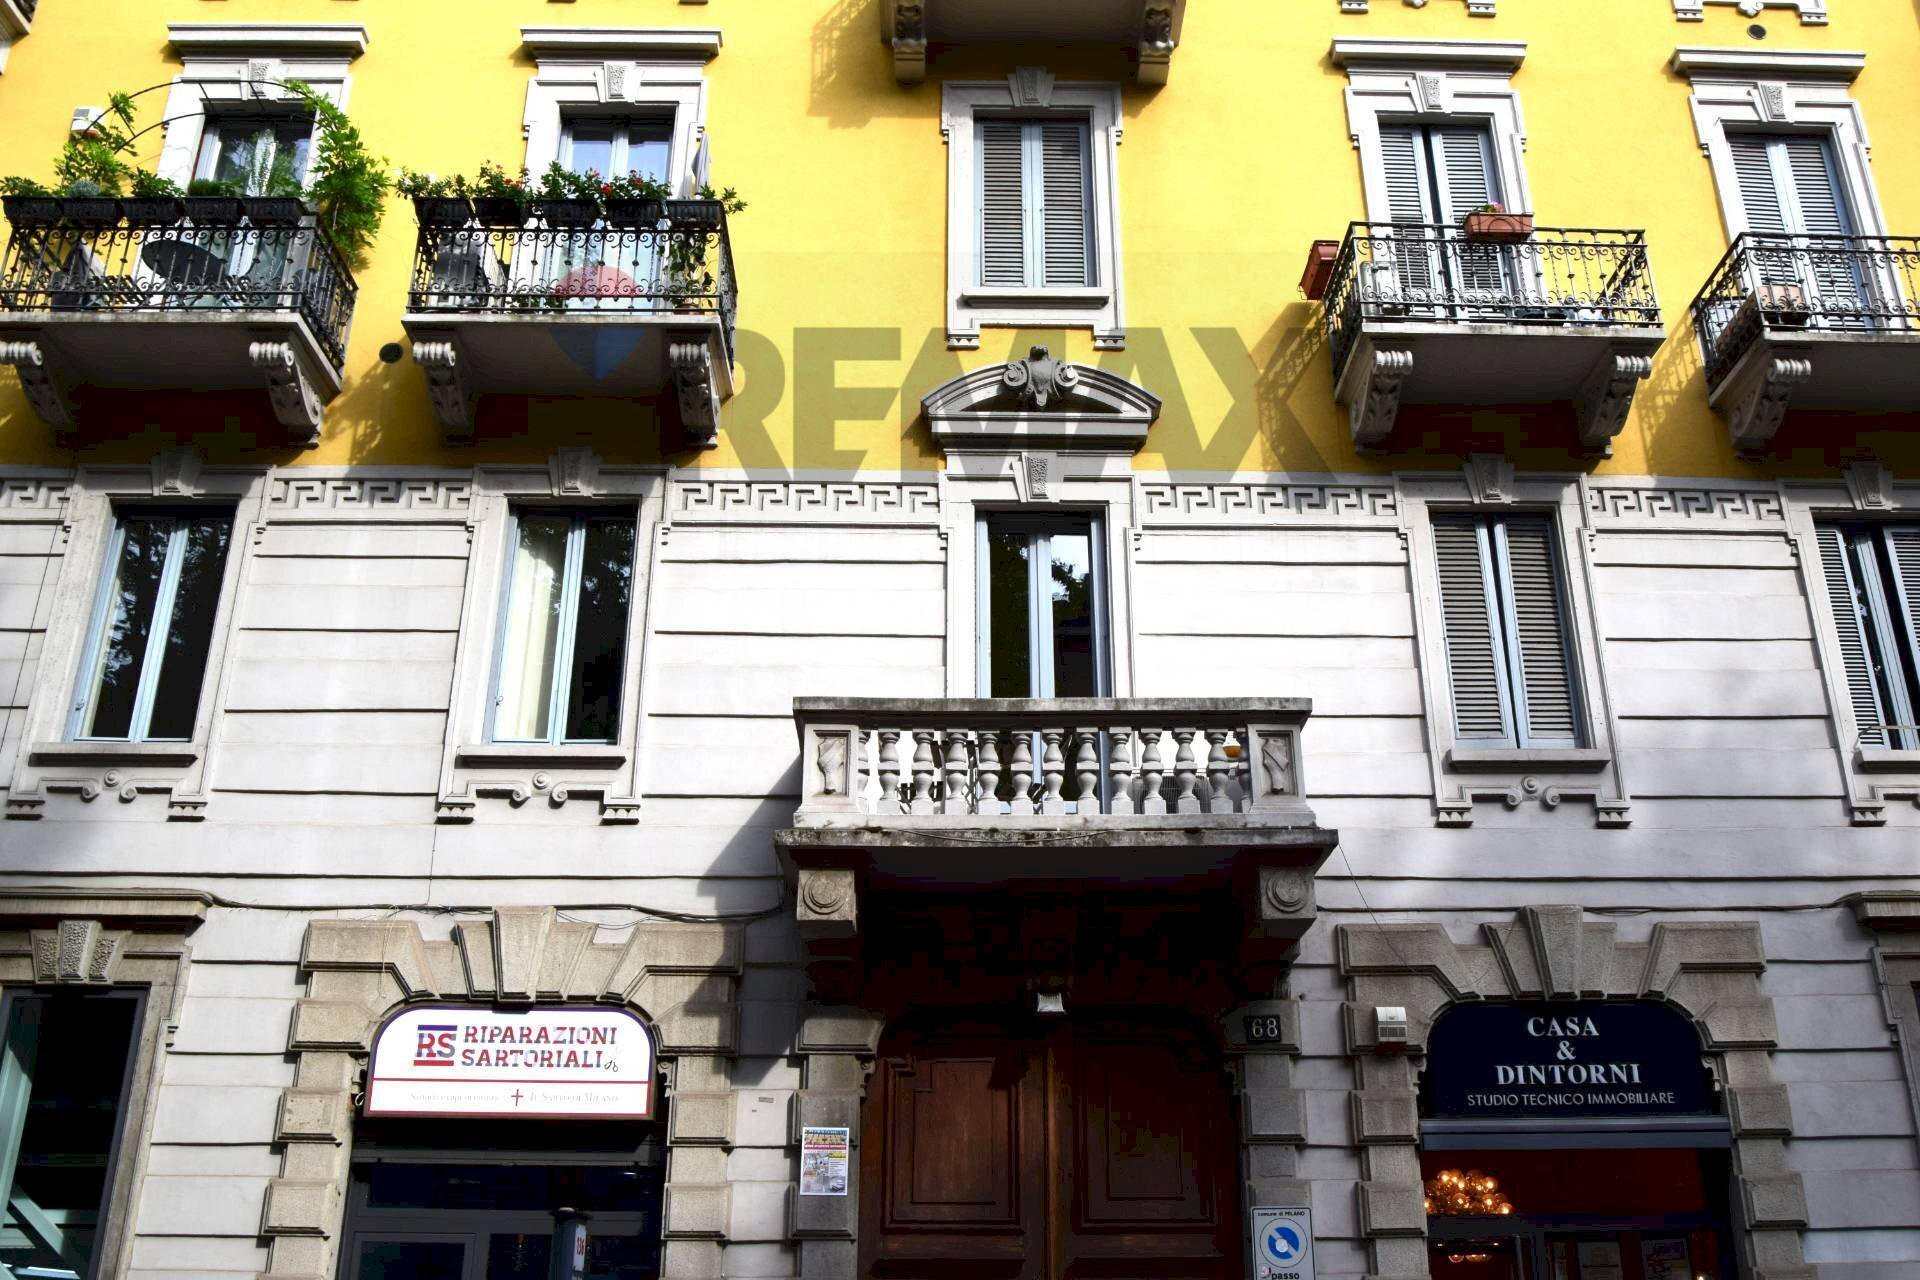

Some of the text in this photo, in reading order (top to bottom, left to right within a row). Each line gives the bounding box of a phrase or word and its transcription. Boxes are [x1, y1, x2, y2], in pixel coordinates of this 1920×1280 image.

[463, 1025, 618, 1045] RIPARAZIONI
[1251, 1018, 1278, 1038] 68
[1526, 1016, 1600, 1037] CASA
[415, 1032, 457, 1058] RS
[1555, 1040, 1577, 1061] &
[460, 1049, 603, 1069] SARTORIALI
[1495, 1063, 1642, 1085] DINTORNI
[1466, 1092, 1676, 1107] STUDIO TECNICO IMMOBILIARE
[1271, 1272, 1300, 1280] passo
